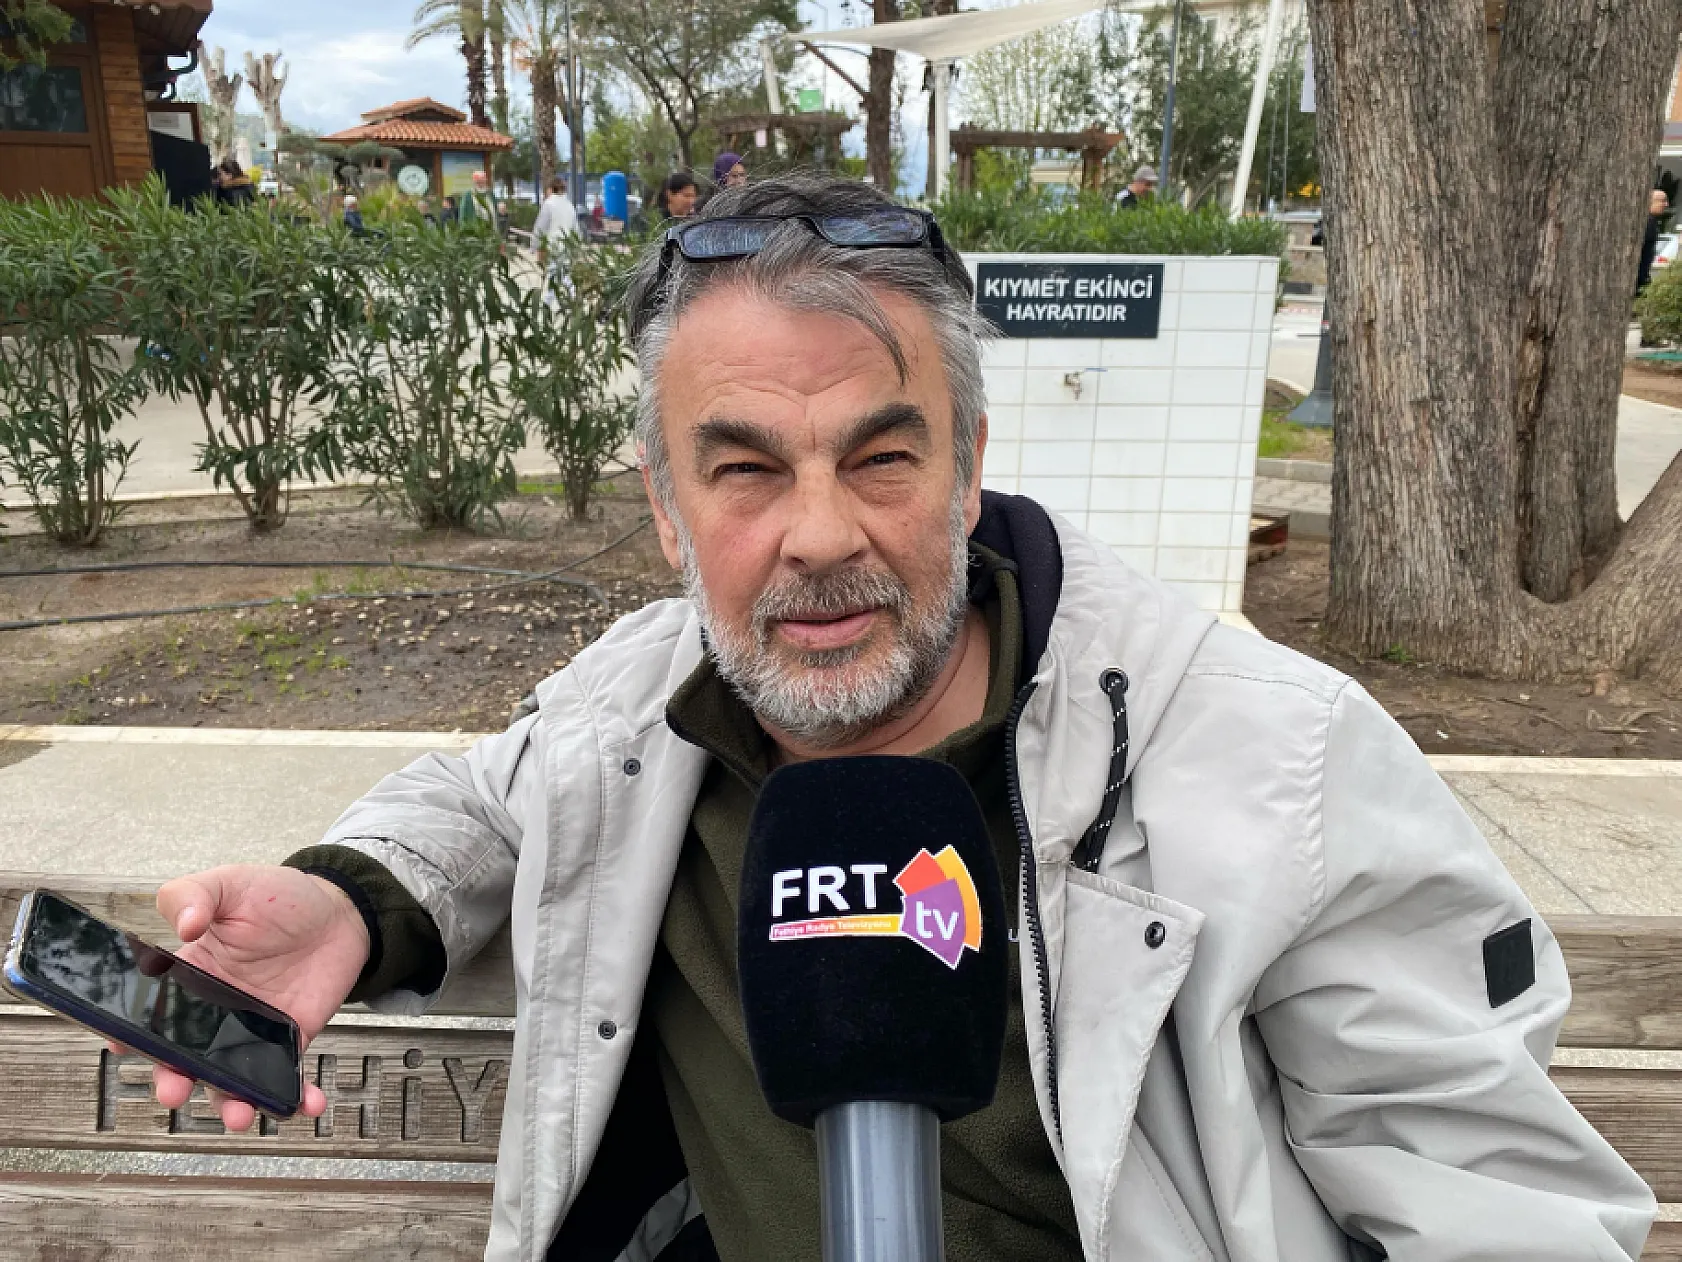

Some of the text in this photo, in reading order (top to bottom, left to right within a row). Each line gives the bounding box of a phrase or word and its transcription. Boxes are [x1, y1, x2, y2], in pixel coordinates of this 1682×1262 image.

[984, 274, 1153, 299] KIYMET EKİNCİ
[1006, 302, 1127, 322] HAYRATIDIR
[772, 864, 888, 917] FRT
[915, 900, 960, 941] tv
